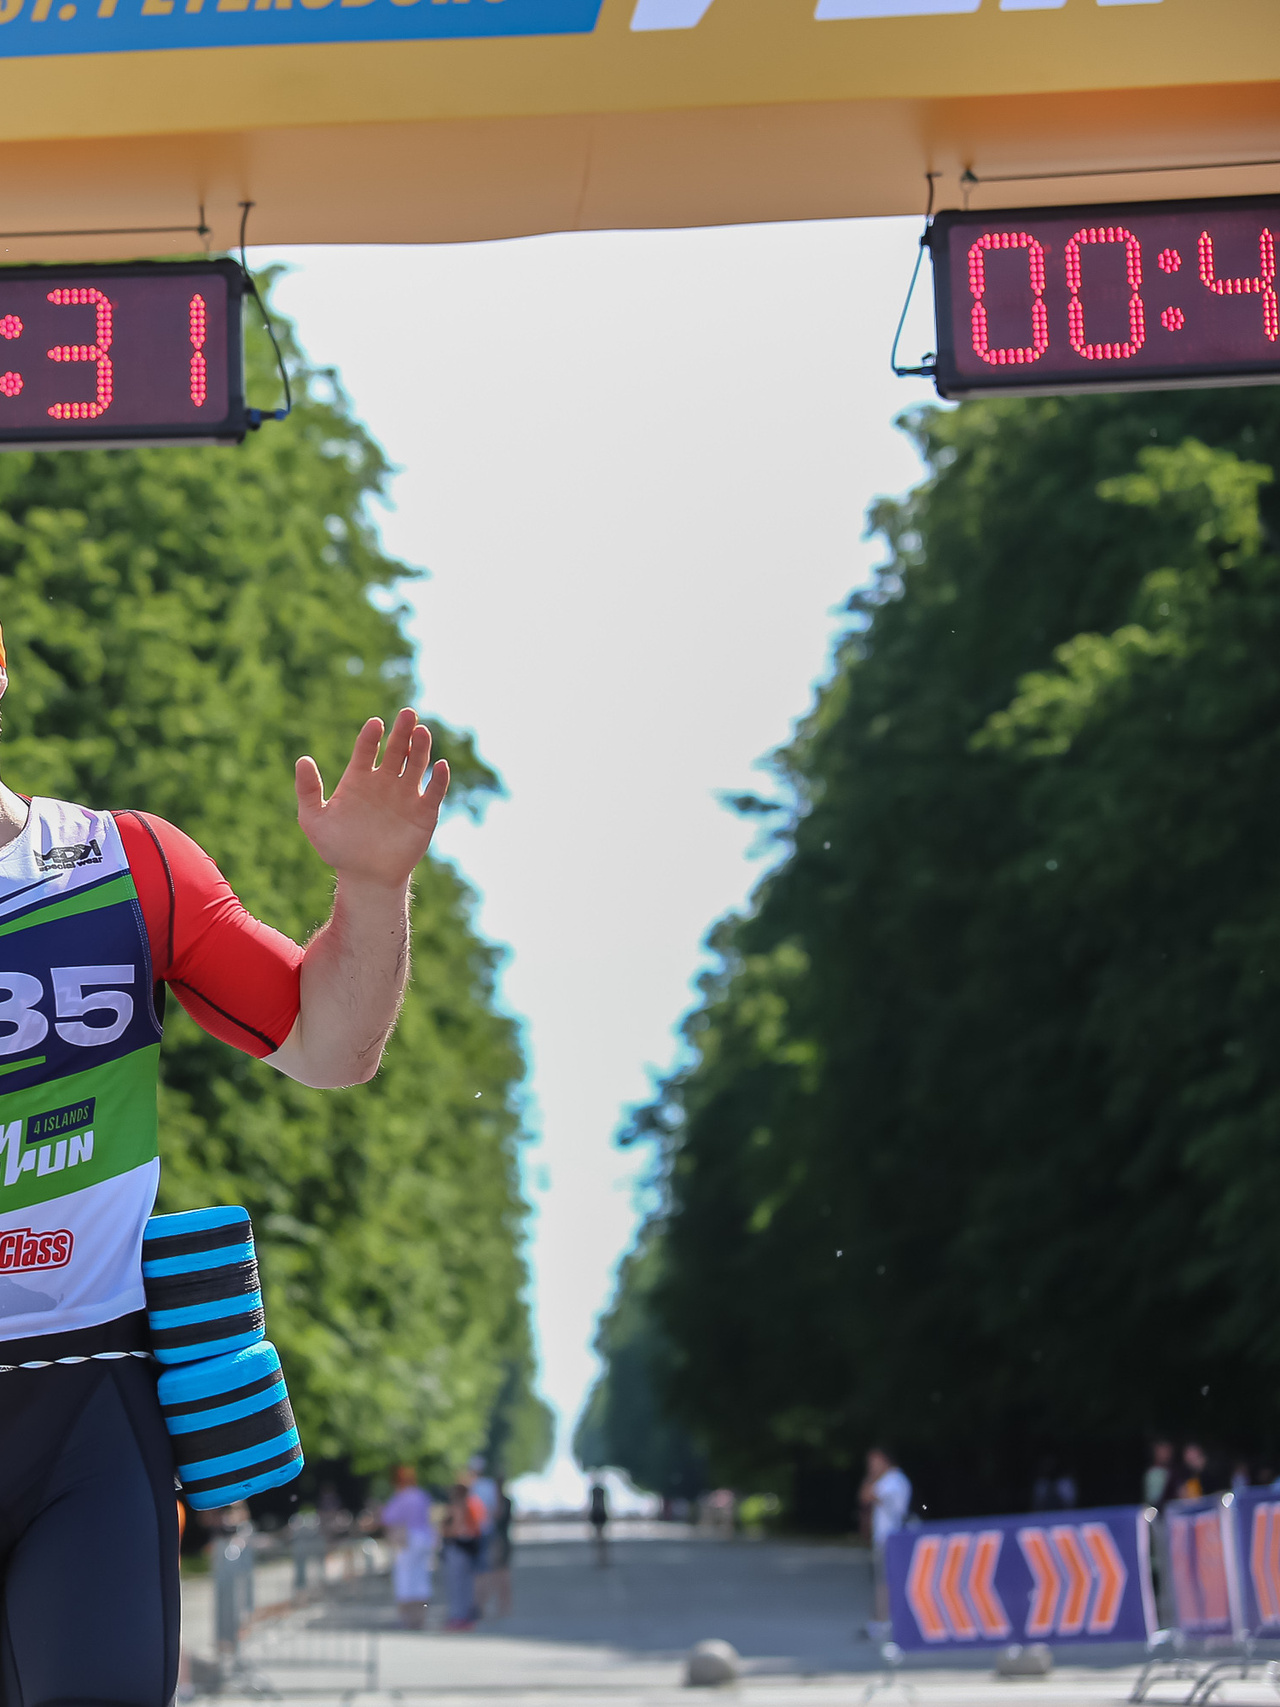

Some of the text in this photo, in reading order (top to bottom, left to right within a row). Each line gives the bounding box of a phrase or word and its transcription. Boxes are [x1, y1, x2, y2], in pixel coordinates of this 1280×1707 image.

[76, 856, 103, 867] wear
[33, 1105, 90, 1135] 4 ISLANDS
